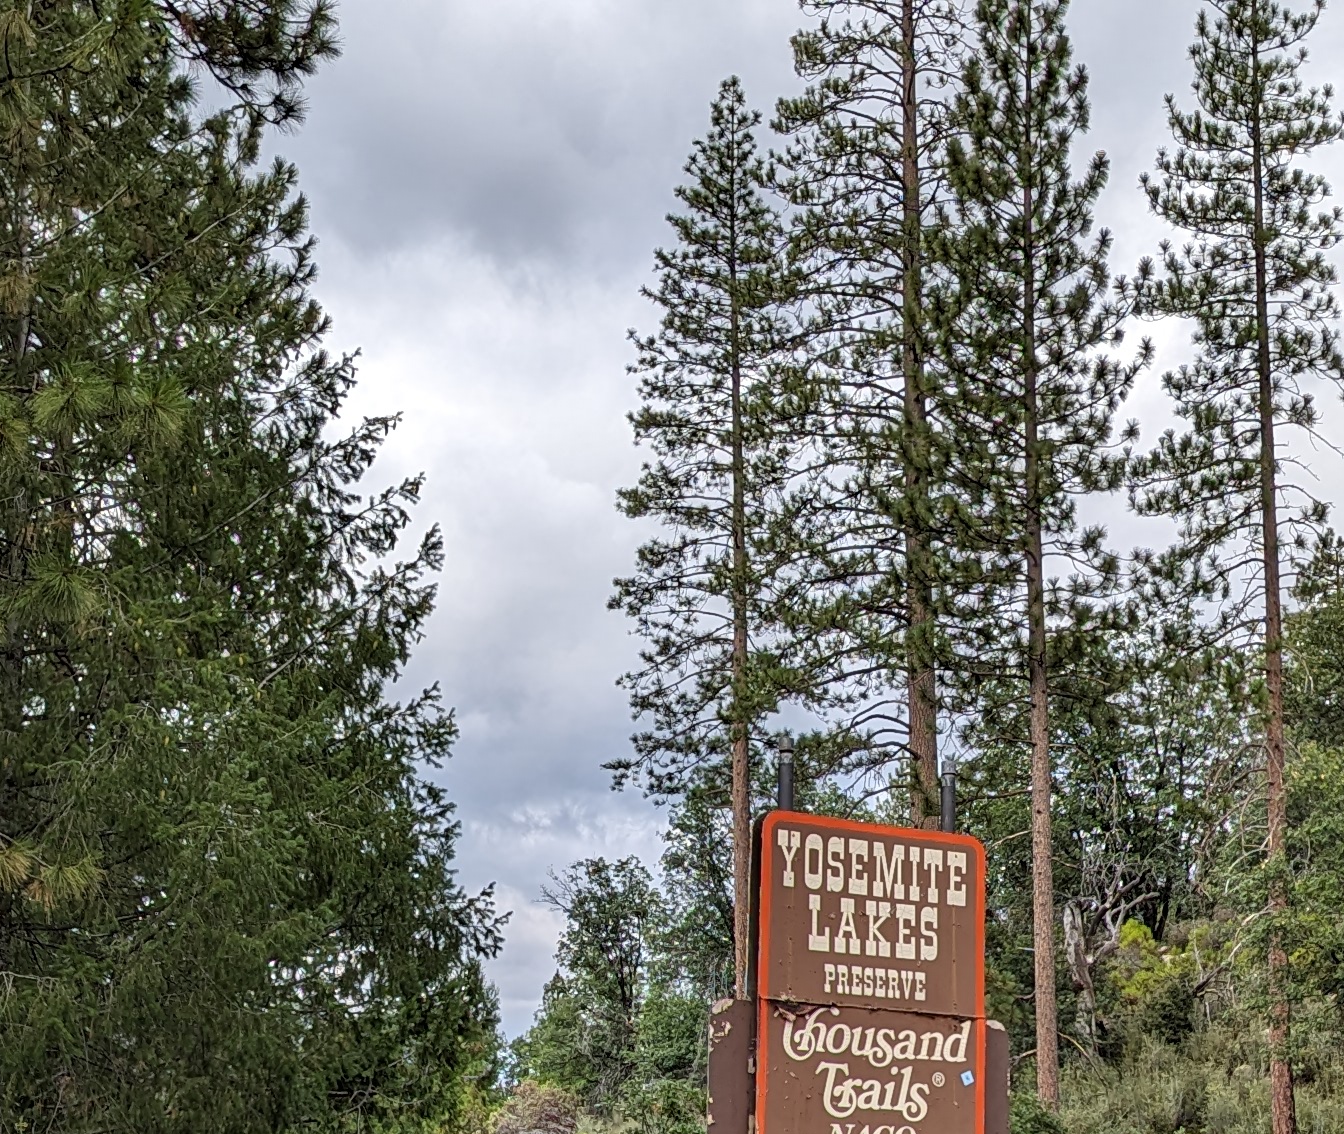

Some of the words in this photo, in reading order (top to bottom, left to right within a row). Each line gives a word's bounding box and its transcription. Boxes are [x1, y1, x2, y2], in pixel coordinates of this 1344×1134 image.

[777, 828, 967, 907] YOSEMITE
[808, 894, 938, 961] LAKES
[824, 963, 926, 1001] PRESERVE
[774, 1006, 971, 1067] Thousand
